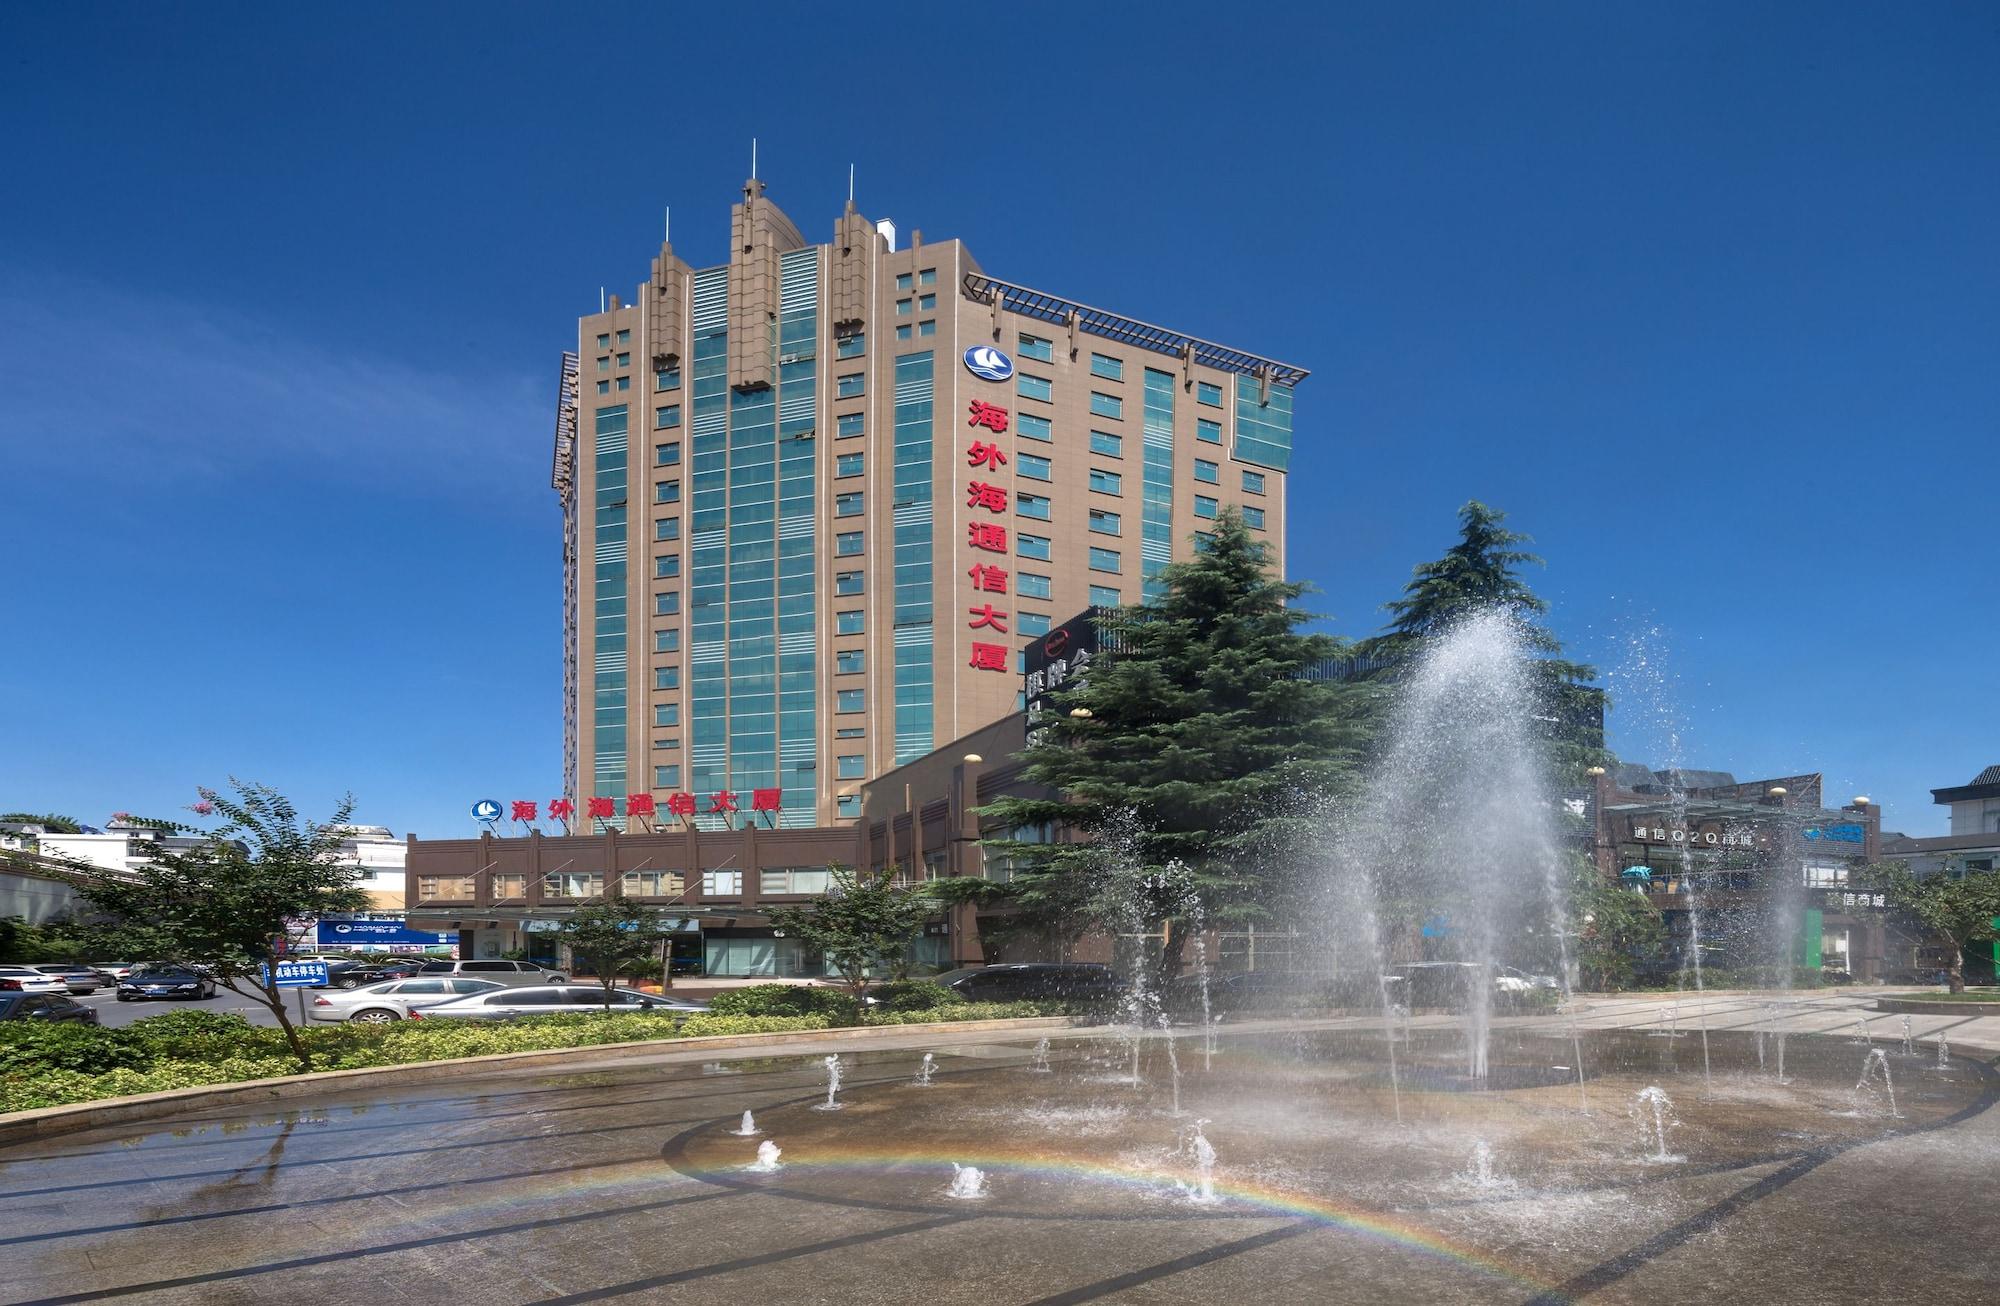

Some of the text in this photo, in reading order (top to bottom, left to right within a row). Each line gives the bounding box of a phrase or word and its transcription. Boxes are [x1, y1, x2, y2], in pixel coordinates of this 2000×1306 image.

[967, 399, 1009, 673] 海外海通信大厦
[511, 788, 783, 822] 海外海通信大厦
